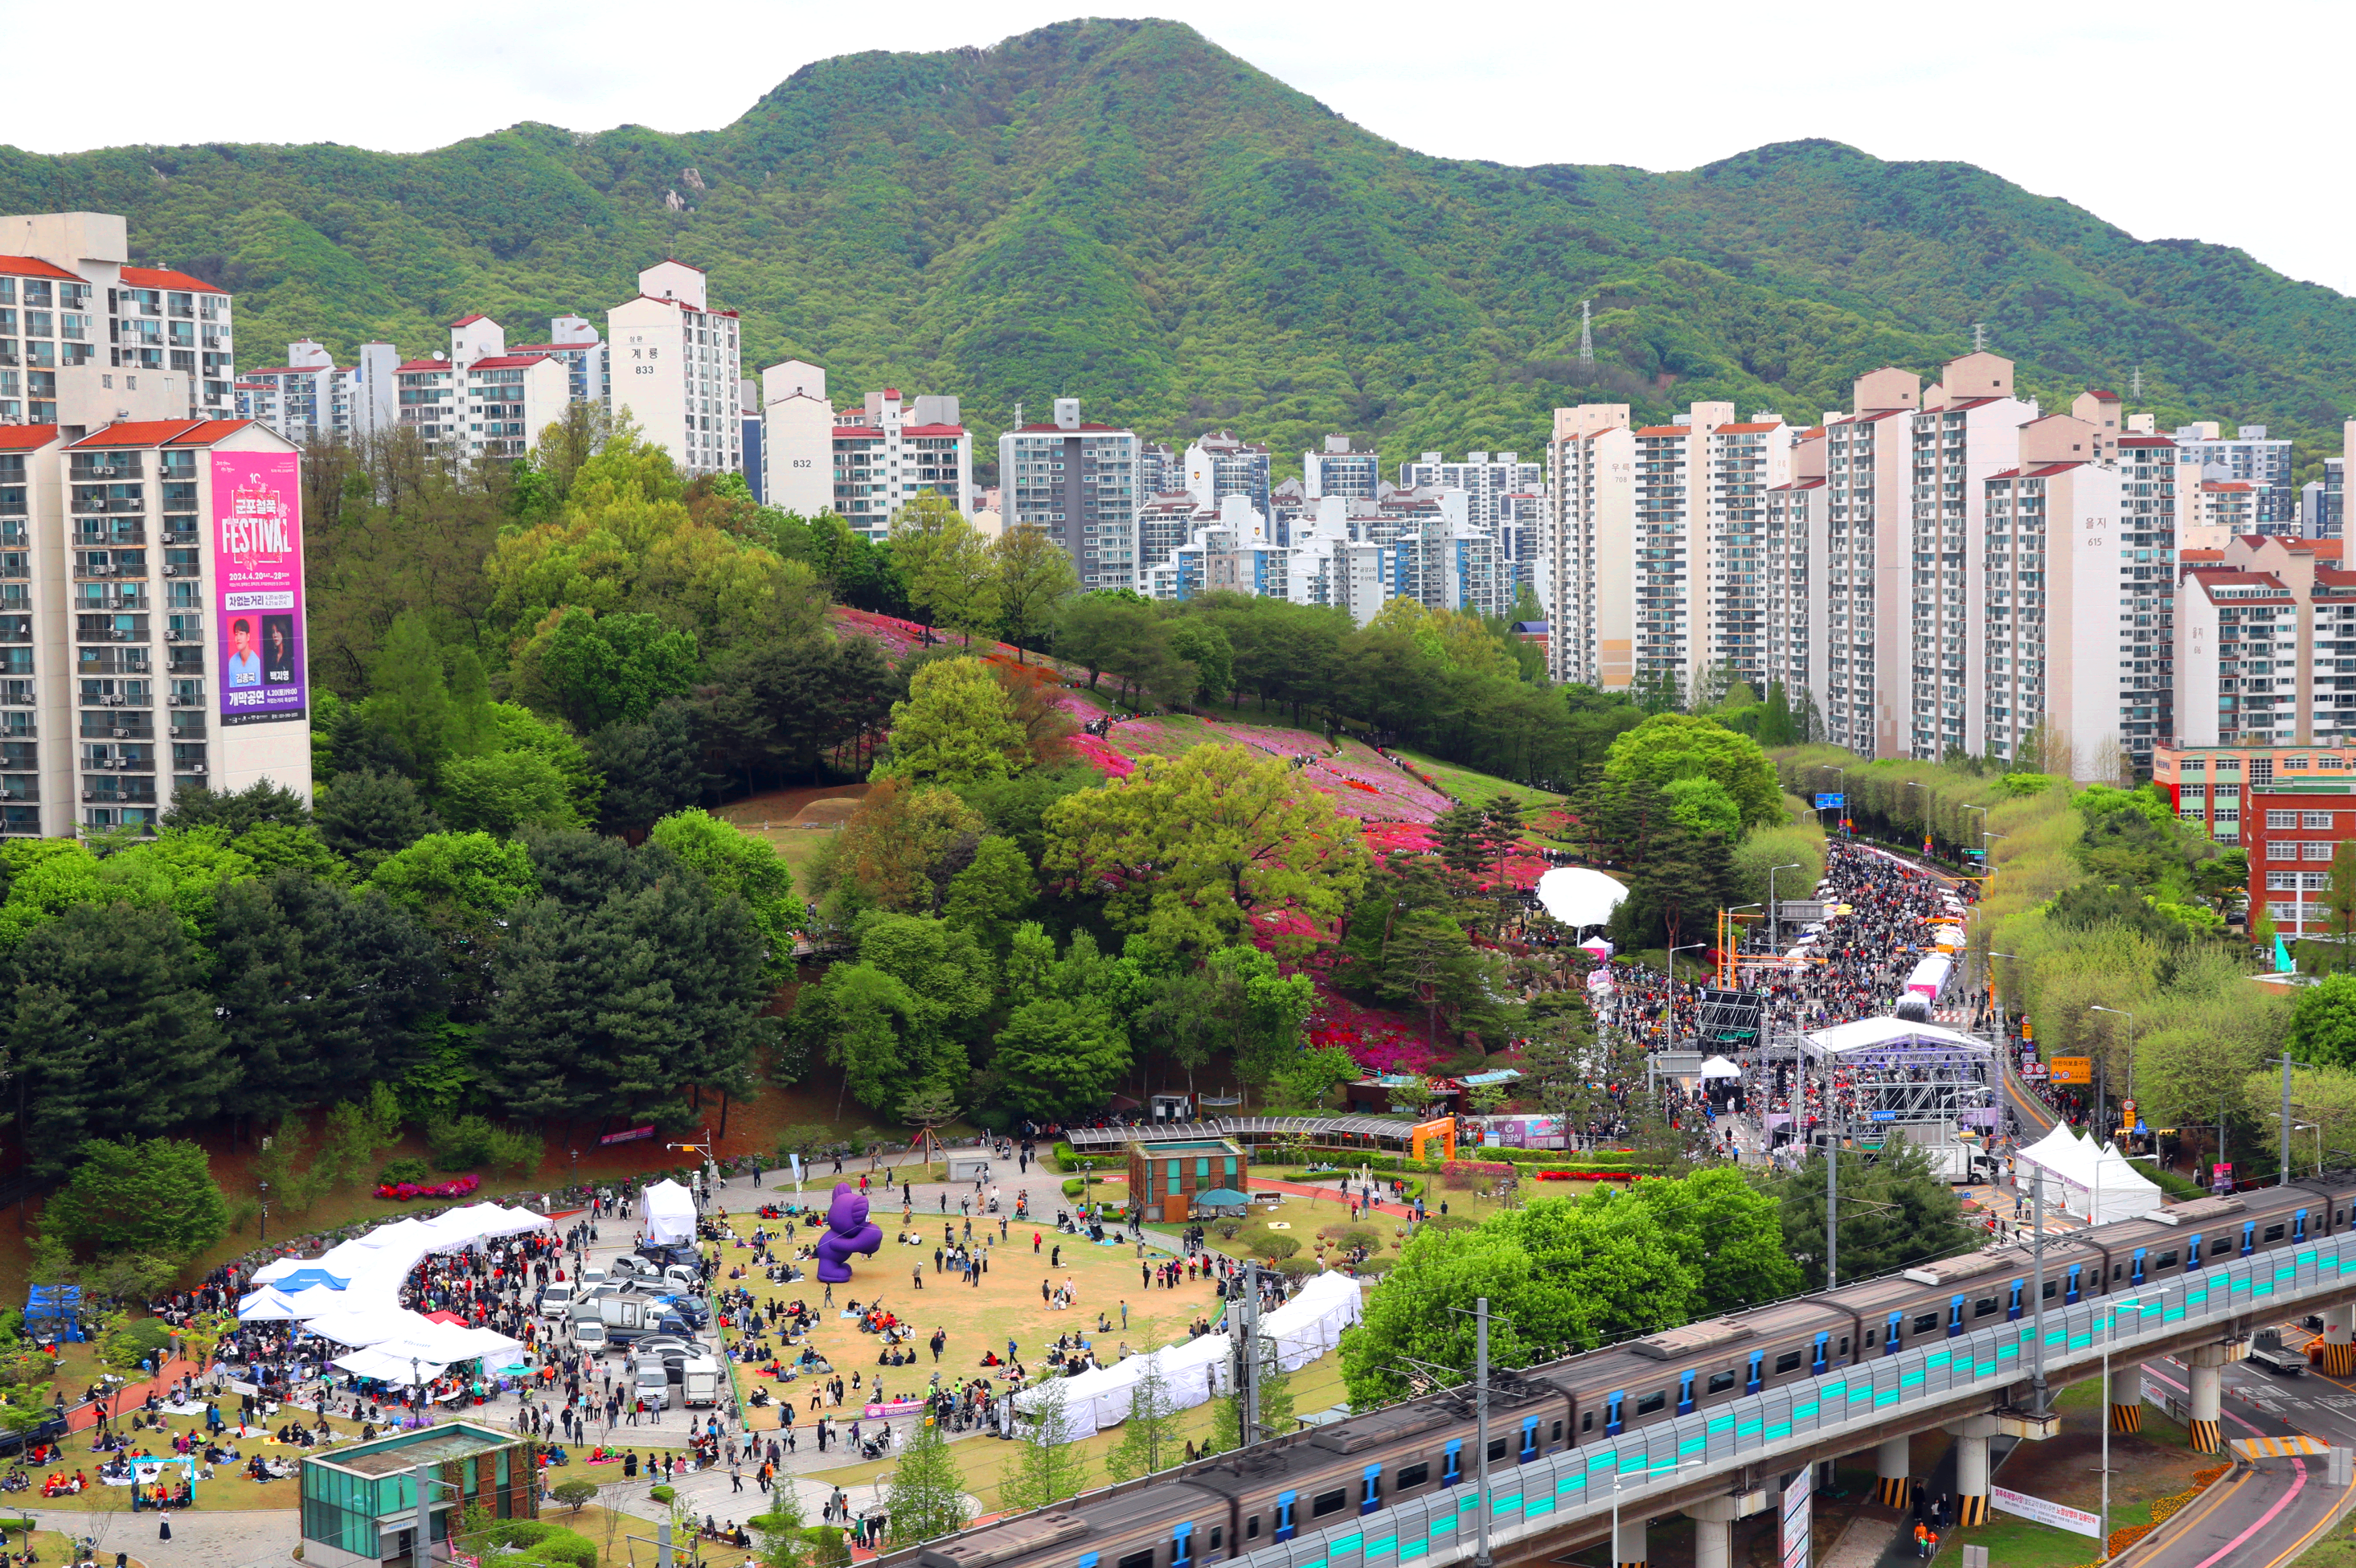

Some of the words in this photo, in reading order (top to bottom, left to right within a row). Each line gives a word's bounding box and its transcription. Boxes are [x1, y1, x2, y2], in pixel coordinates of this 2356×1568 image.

[635, 365, 654, 375] 833
[793, 459, 812, 468] 832
[236, 499, 277, 514] 군포철쭉
[2085, 517, 2107, 530] 을지
[222, 518, 293, 554] FESTIVAL
[2088, 538, 2102, 547] 615
[228, 595, 264, 608] 차없는거리
[236, 672, 256, 684] 김종국
[269, 669, 289, 682] 백지영
[228, 690, 265, 706] 개막공연
